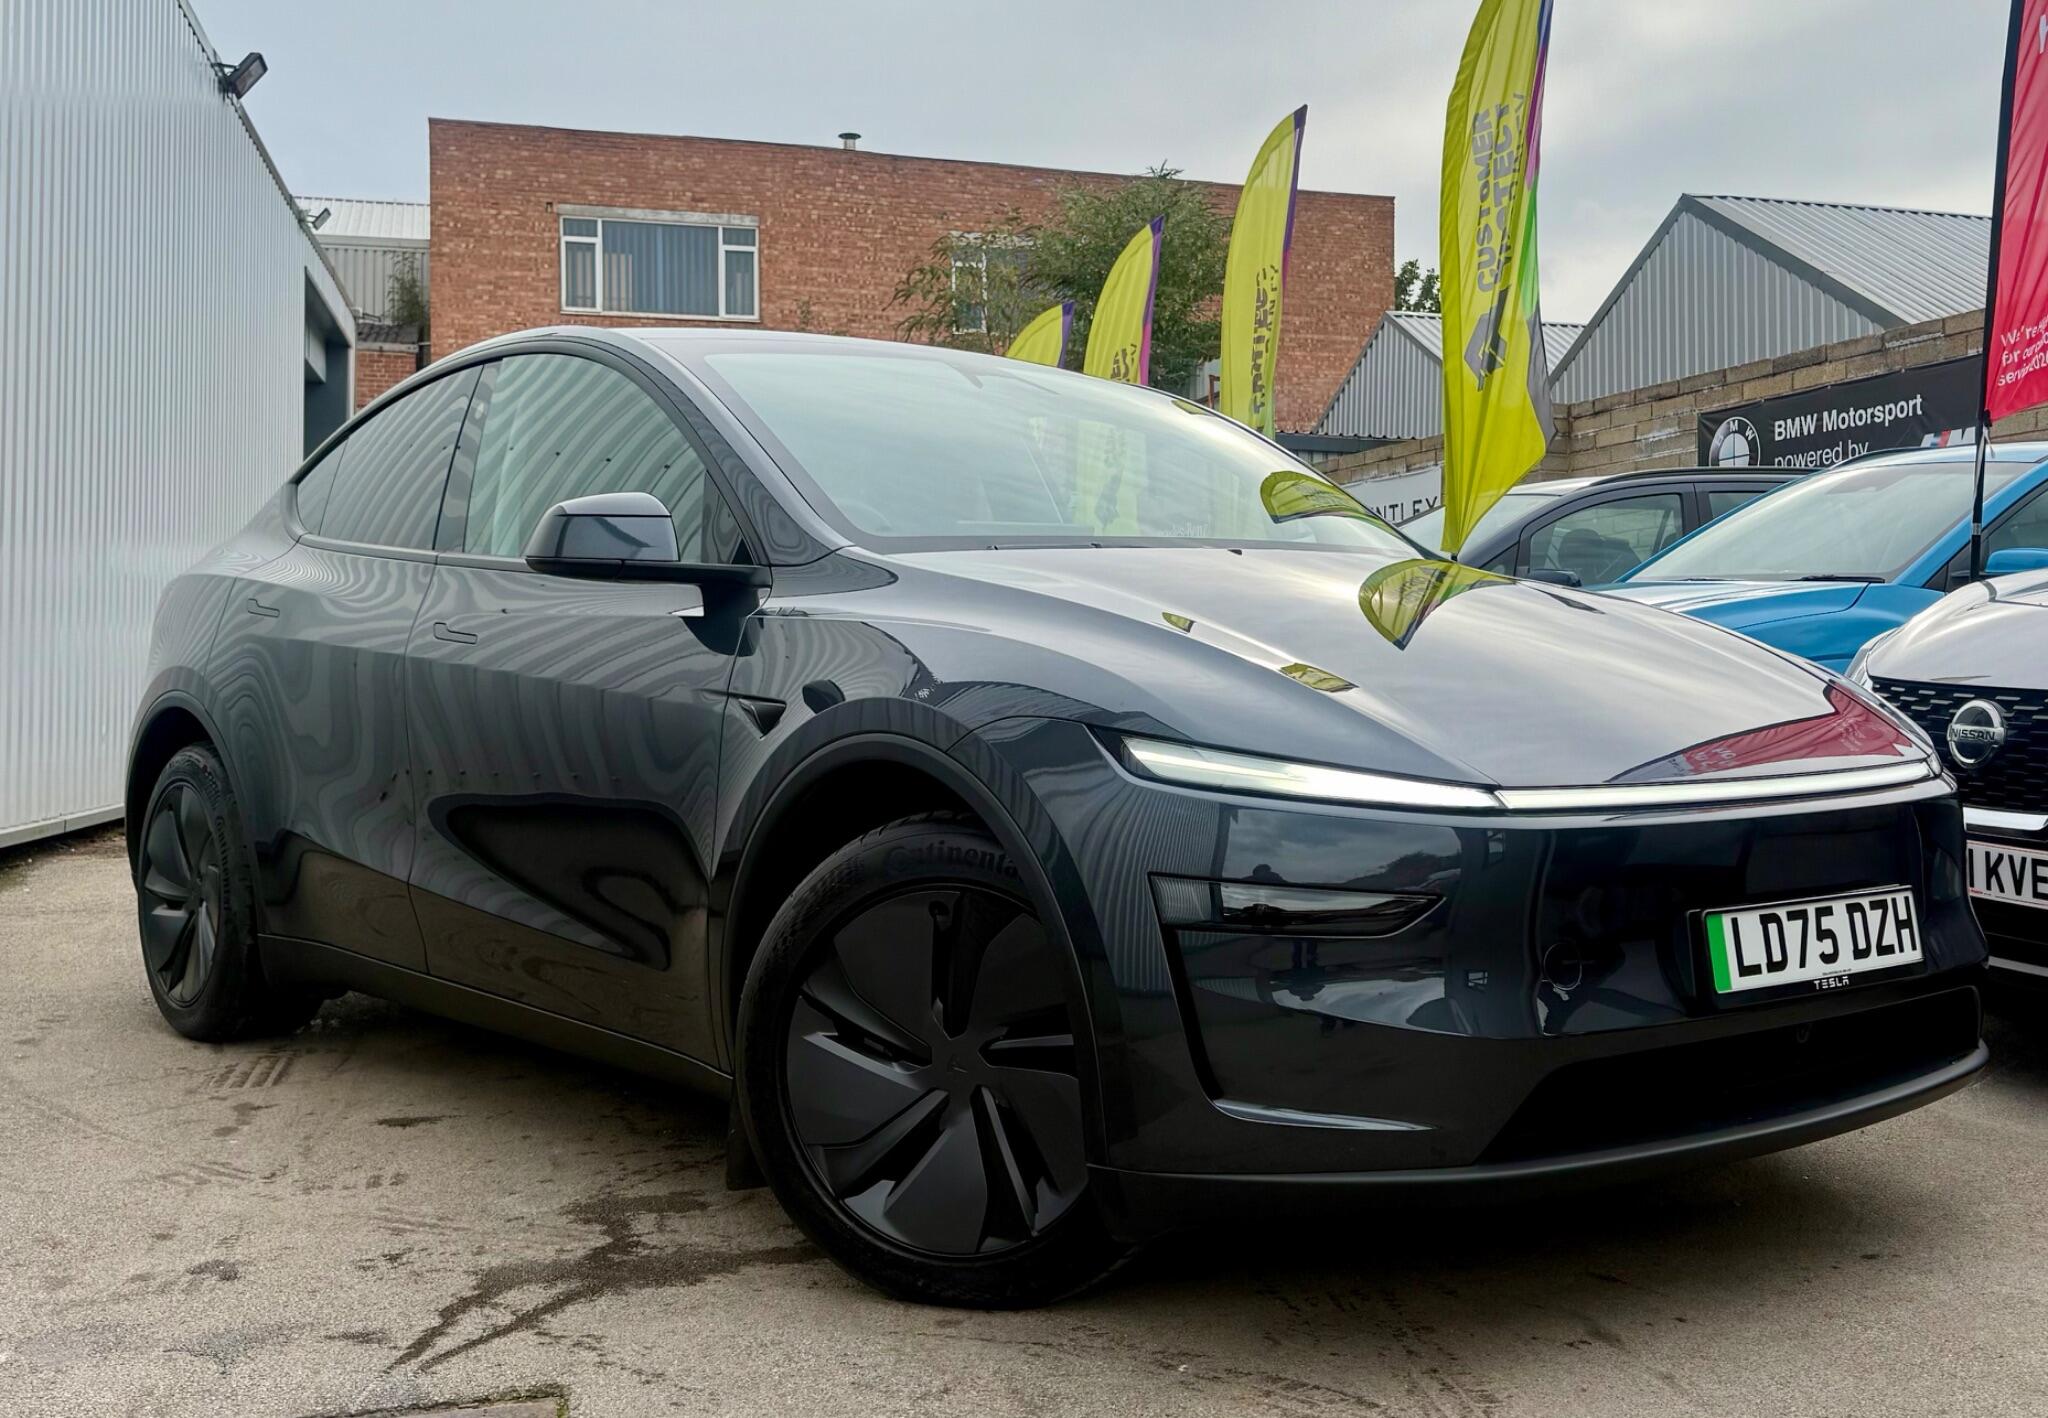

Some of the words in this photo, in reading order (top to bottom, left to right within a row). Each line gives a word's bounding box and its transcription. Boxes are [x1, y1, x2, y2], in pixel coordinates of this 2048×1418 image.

[1472, 108, 1498, 292] CUSTOMER
[1775, 413, 1817, 441] BMW
[1823, 394, 1923, 431] Motorsport
[1774, 441, 1844, 467] powered
[1848, 439, 1869, 460] by
[1374, 496, 1438, 520] NTLEY
[1951, 728, 1995, 742] NISSAN
[1985, 851, 2048, 900] KVE
[1731, 905, 1840, 977] LD75
[1845, 896, 1917, 960] DZH
[1813, 976, 1849, 990] TESLA
